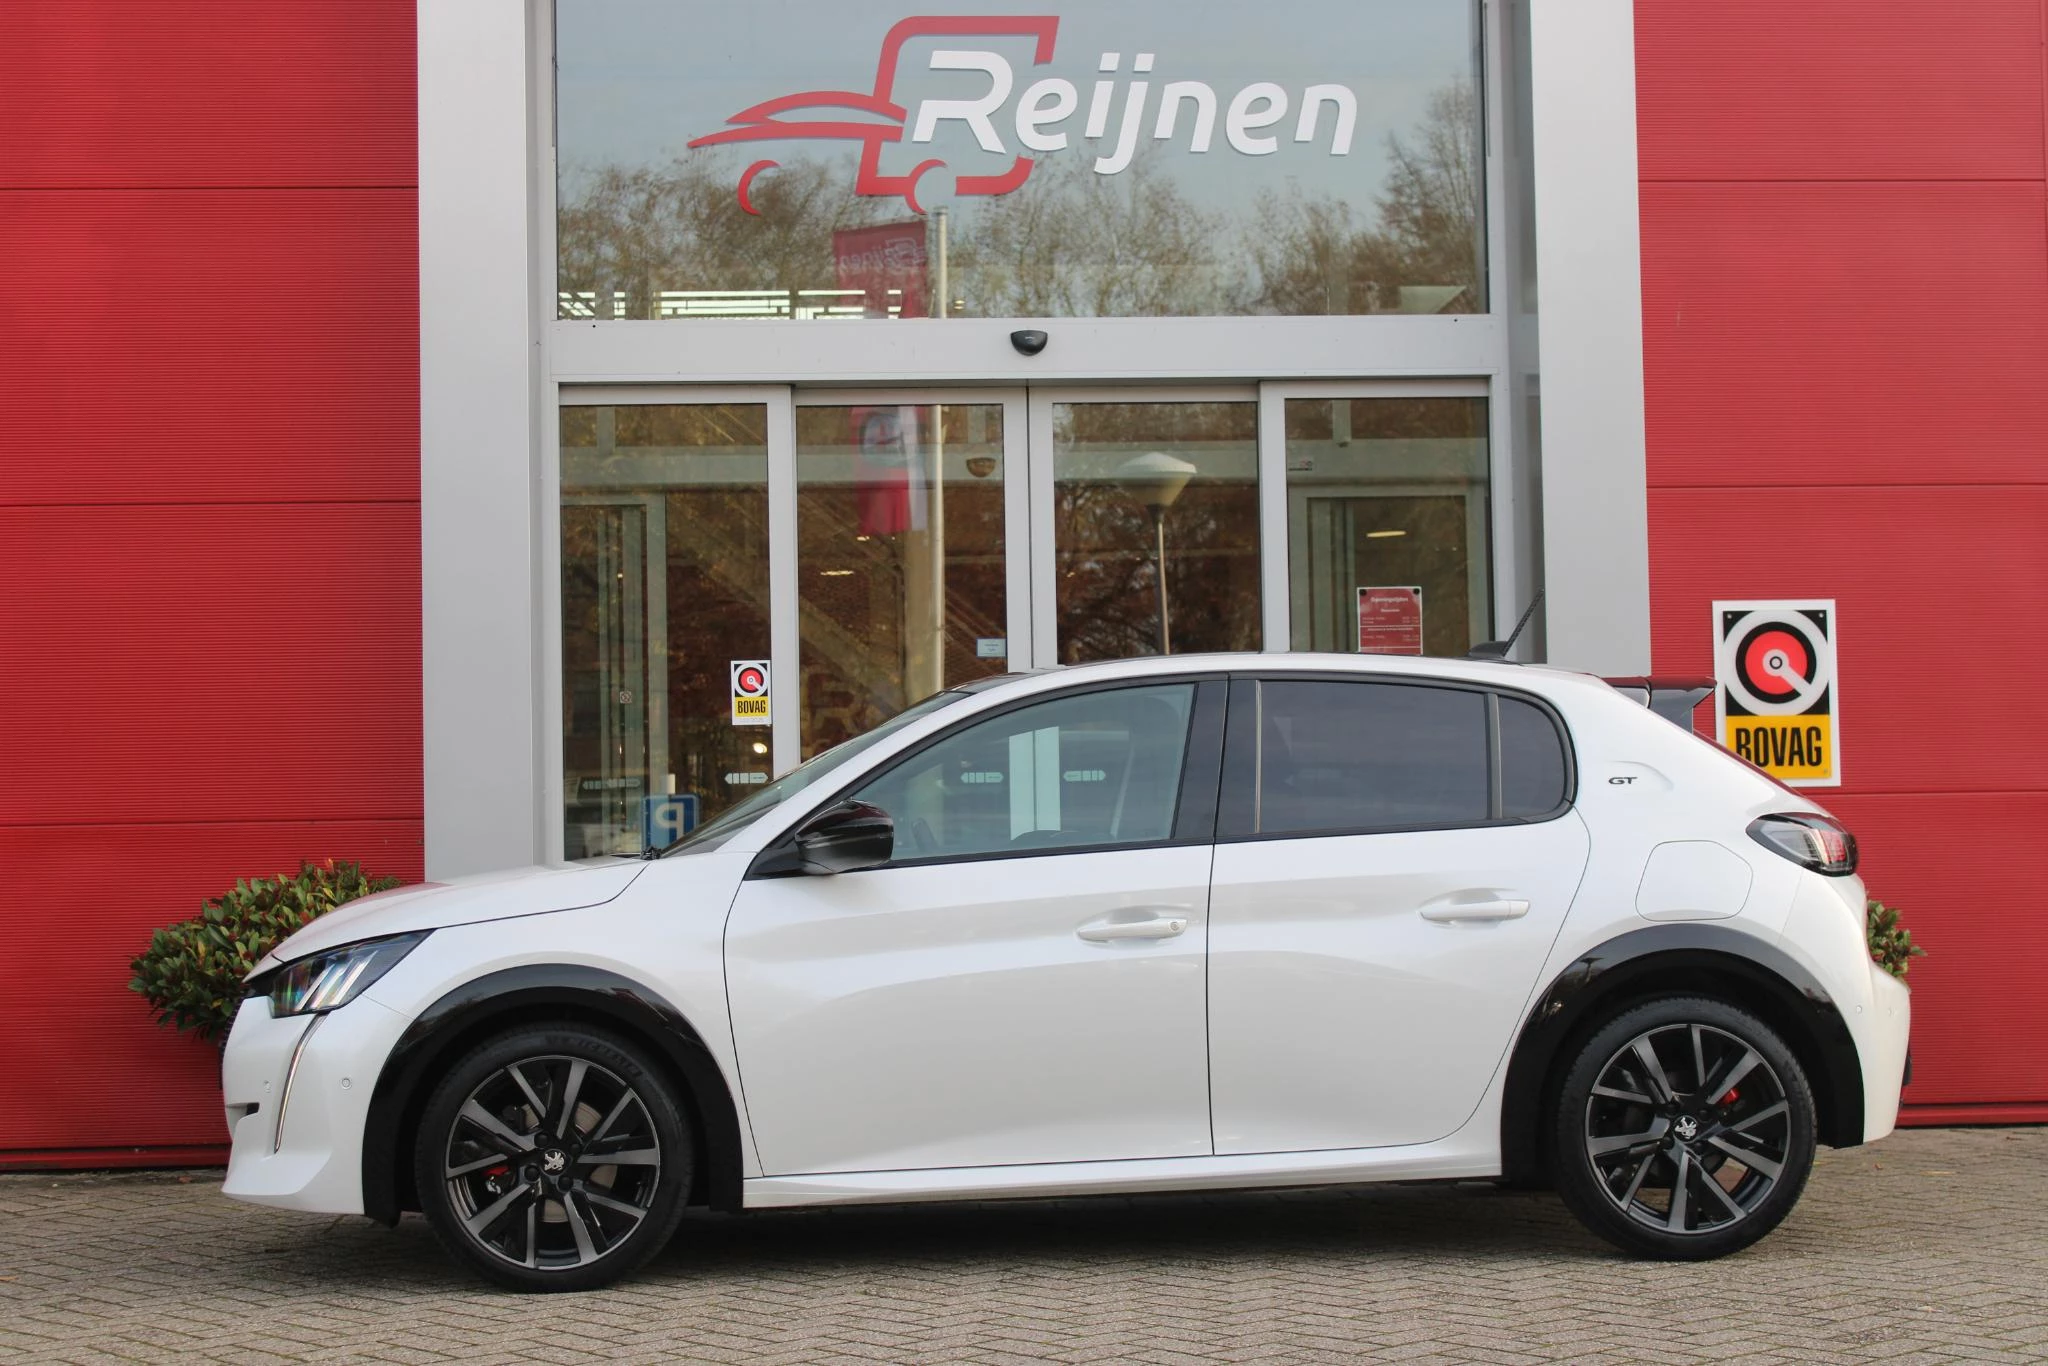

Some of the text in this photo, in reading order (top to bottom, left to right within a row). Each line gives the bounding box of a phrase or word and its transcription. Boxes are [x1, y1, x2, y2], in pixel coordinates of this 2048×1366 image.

[912, 50, 1358, 175] Reijnen
[737, 700, 766, 713] BOVAG
[1735, 726, 1822, 767] BOVAG
[1608, 776, 1638, 785] GT
